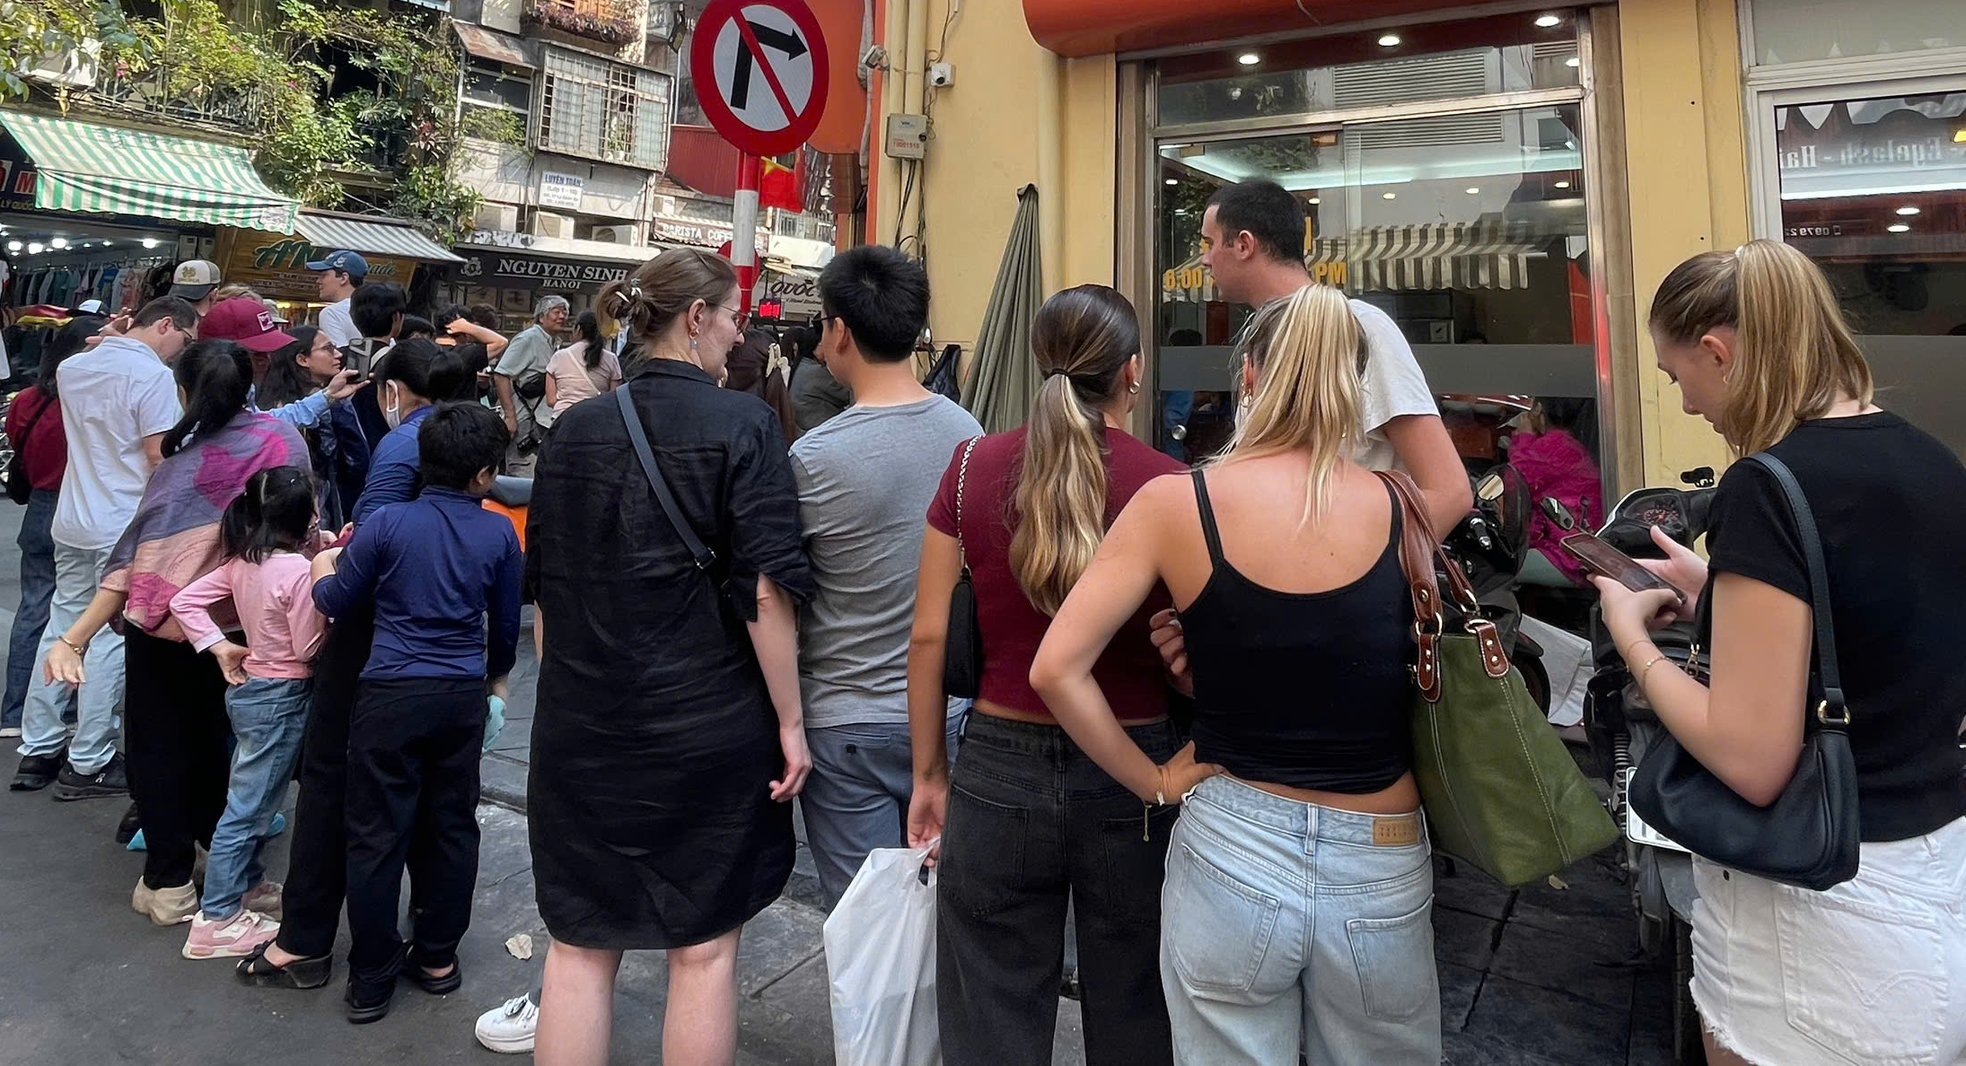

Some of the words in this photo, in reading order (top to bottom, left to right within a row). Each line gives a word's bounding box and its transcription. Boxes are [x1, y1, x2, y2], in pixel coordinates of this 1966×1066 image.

[497, 259, 581, 278] NGUYEN
[583, 266, 628, 281] SINH
[1315, 263, 1347, 285] PM
[543, 279, 581, 289] HANOI
